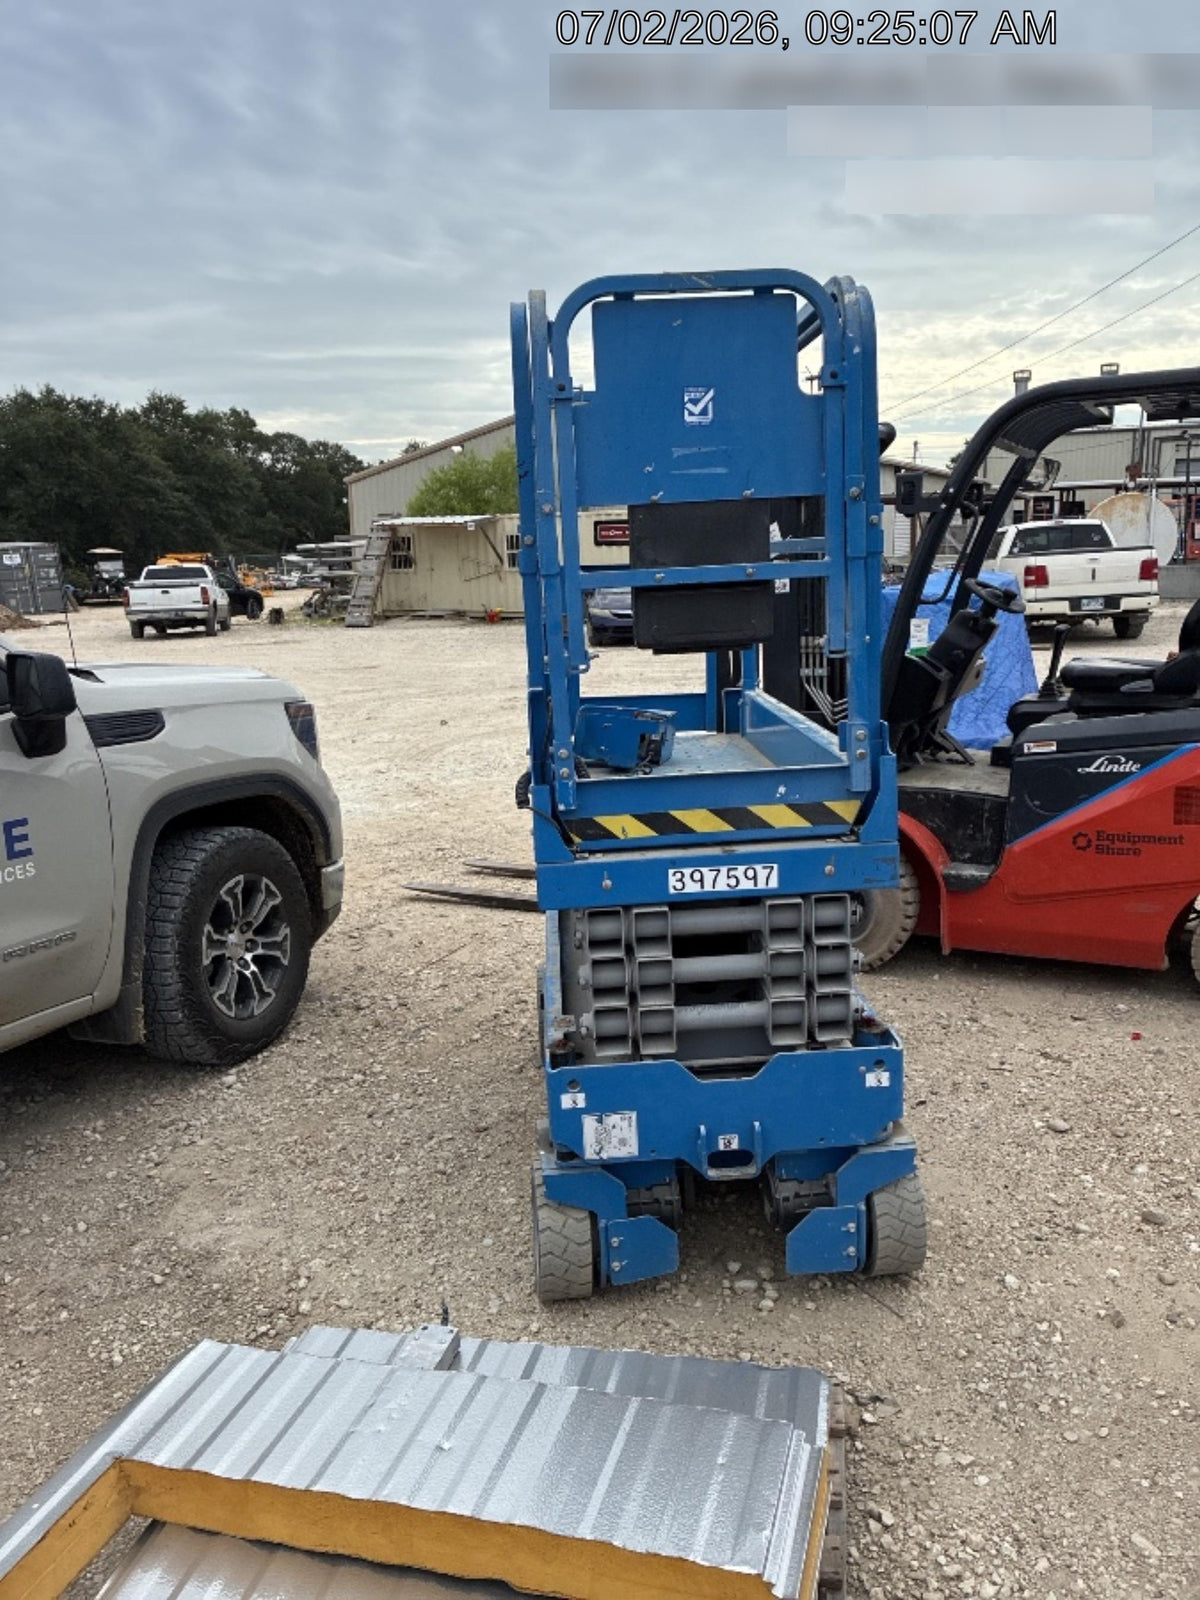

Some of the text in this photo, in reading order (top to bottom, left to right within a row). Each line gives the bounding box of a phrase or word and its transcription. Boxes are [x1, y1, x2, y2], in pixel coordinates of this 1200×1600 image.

[1077, 755, 1142, 774] Linde
[1095, 829, 1185, 846] Equipment
[1095, 843, 1143, 857] Share
[671, 865, 775, 892] 397597
